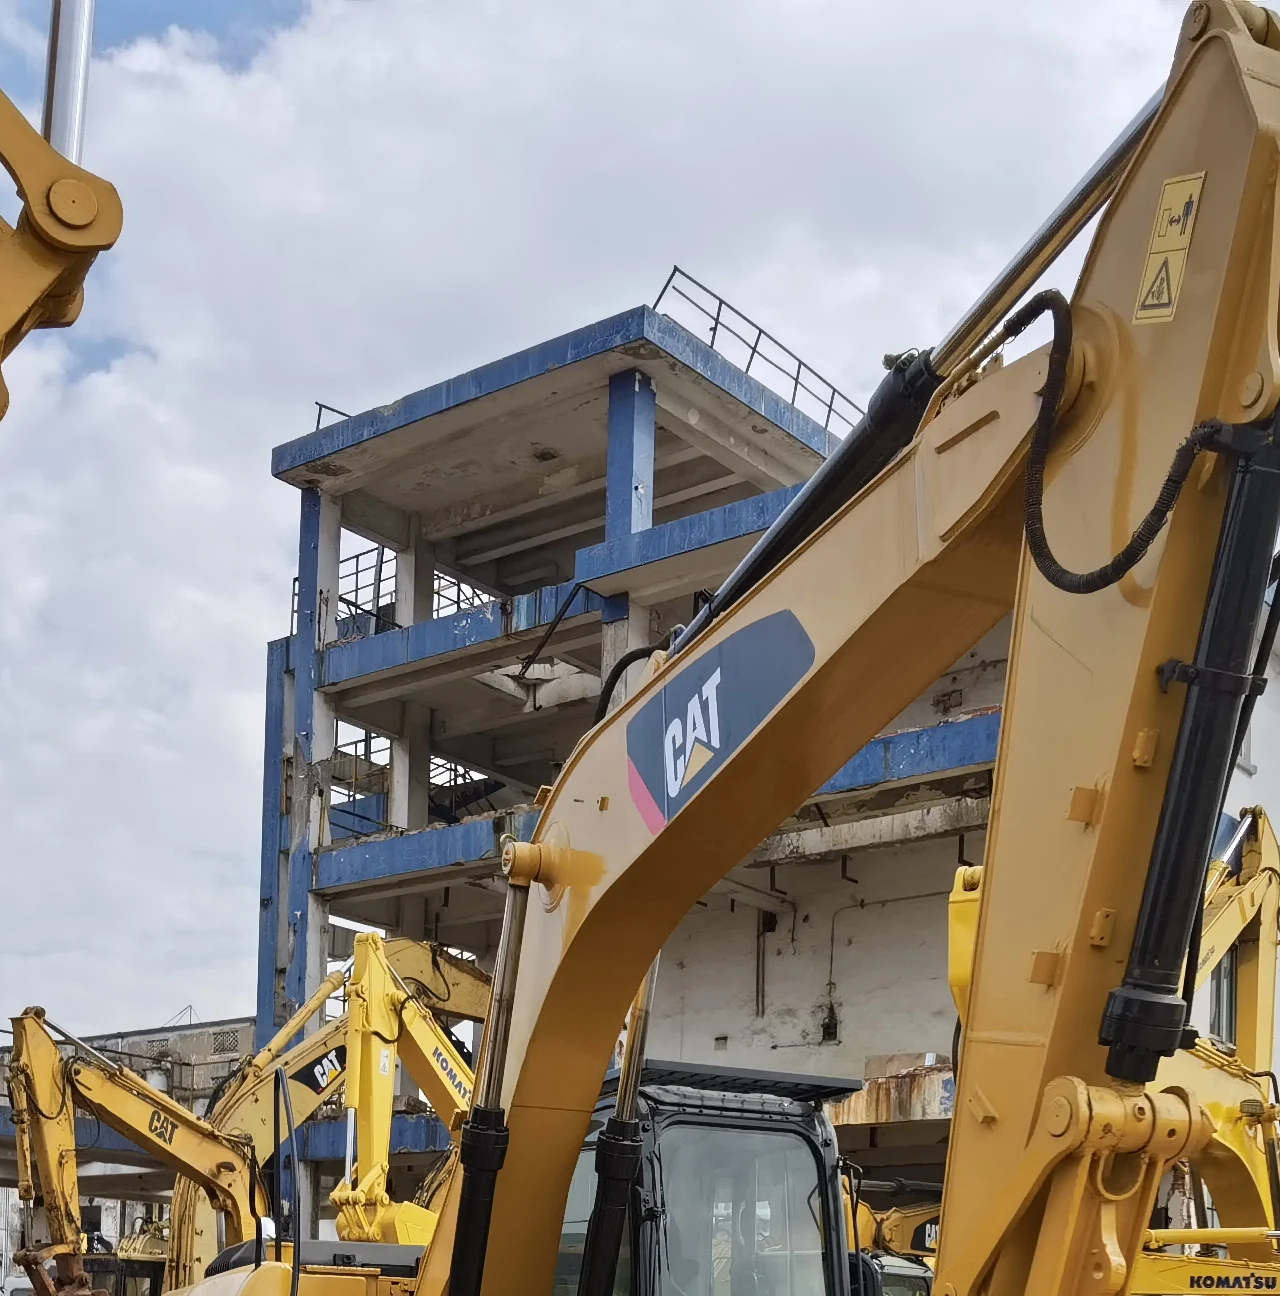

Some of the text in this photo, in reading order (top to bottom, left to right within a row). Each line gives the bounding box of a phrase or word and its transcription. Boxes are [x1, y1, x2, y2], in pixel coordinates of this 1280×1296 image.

[665, 667, 721, 797] CAT
[314, 1050, 342, 1087] CAT
[149, 1109, 179, 1146] CAT
[1189, 1273, 1277, 1289] KOMATSU
